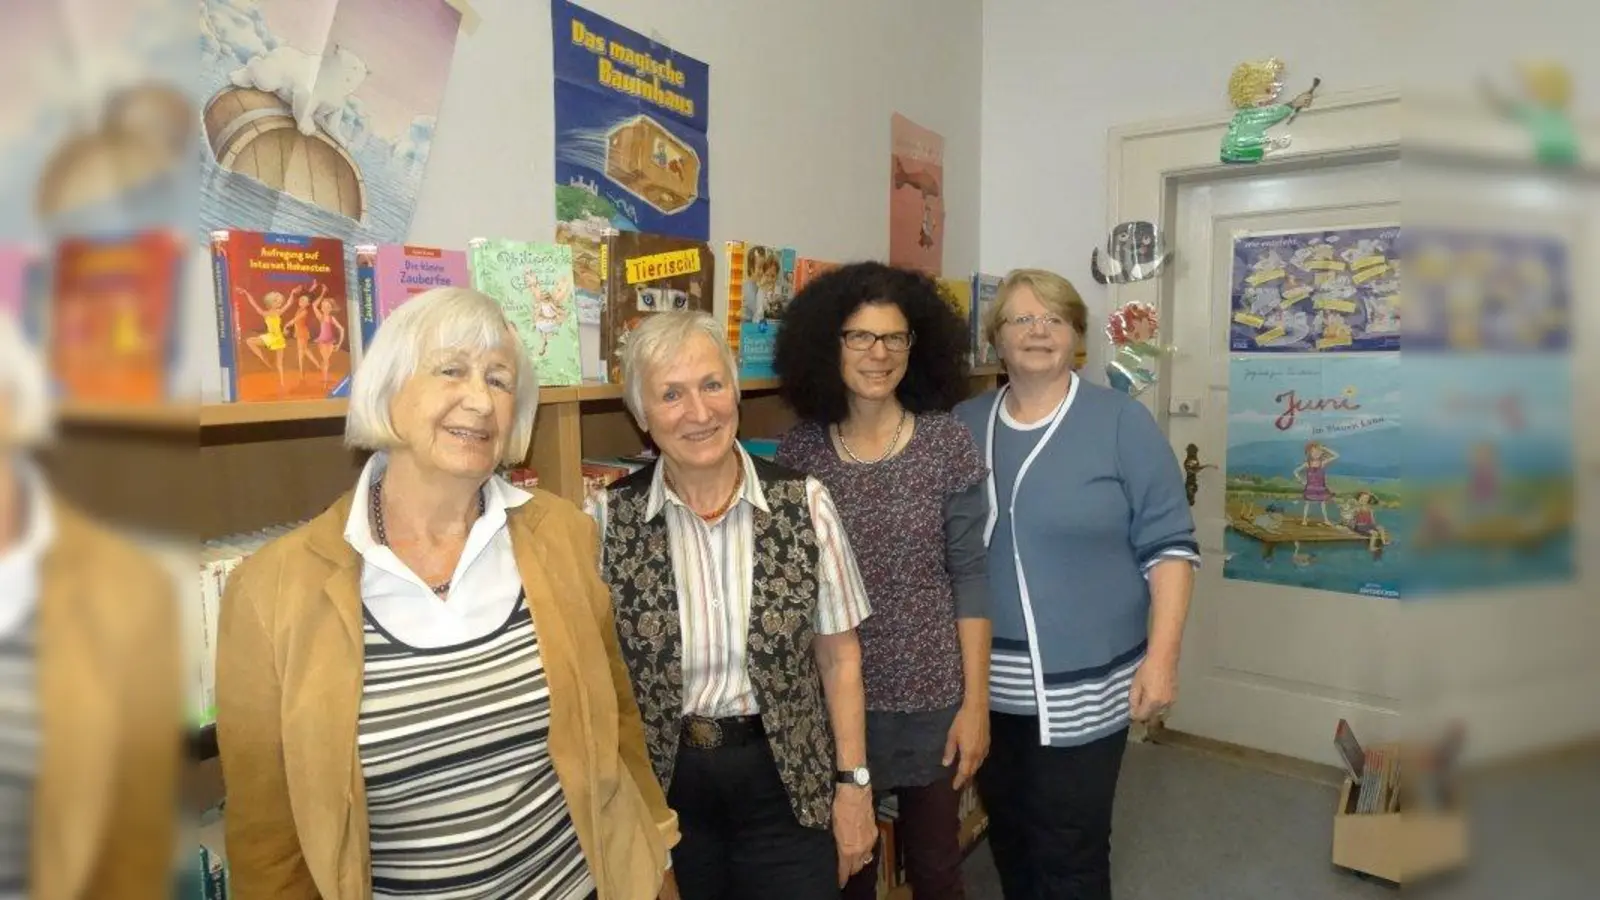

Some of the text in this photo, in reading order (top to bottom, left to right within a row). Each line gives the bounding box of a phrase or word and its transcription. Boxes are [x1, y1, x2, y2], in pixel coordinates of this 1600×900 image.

[571, 18, 685, 88] Das magische
[599, 57, 694, 117] Baumhaus
[260, 247, 320, 261] Aufregung auf
[405, 260, 445, 272] Die kleine
[632, 251, 695, 281] Tierisch!
[399, 271, 452, 287] Zauberfee
[1274, 388, 1362, 431] Juni
